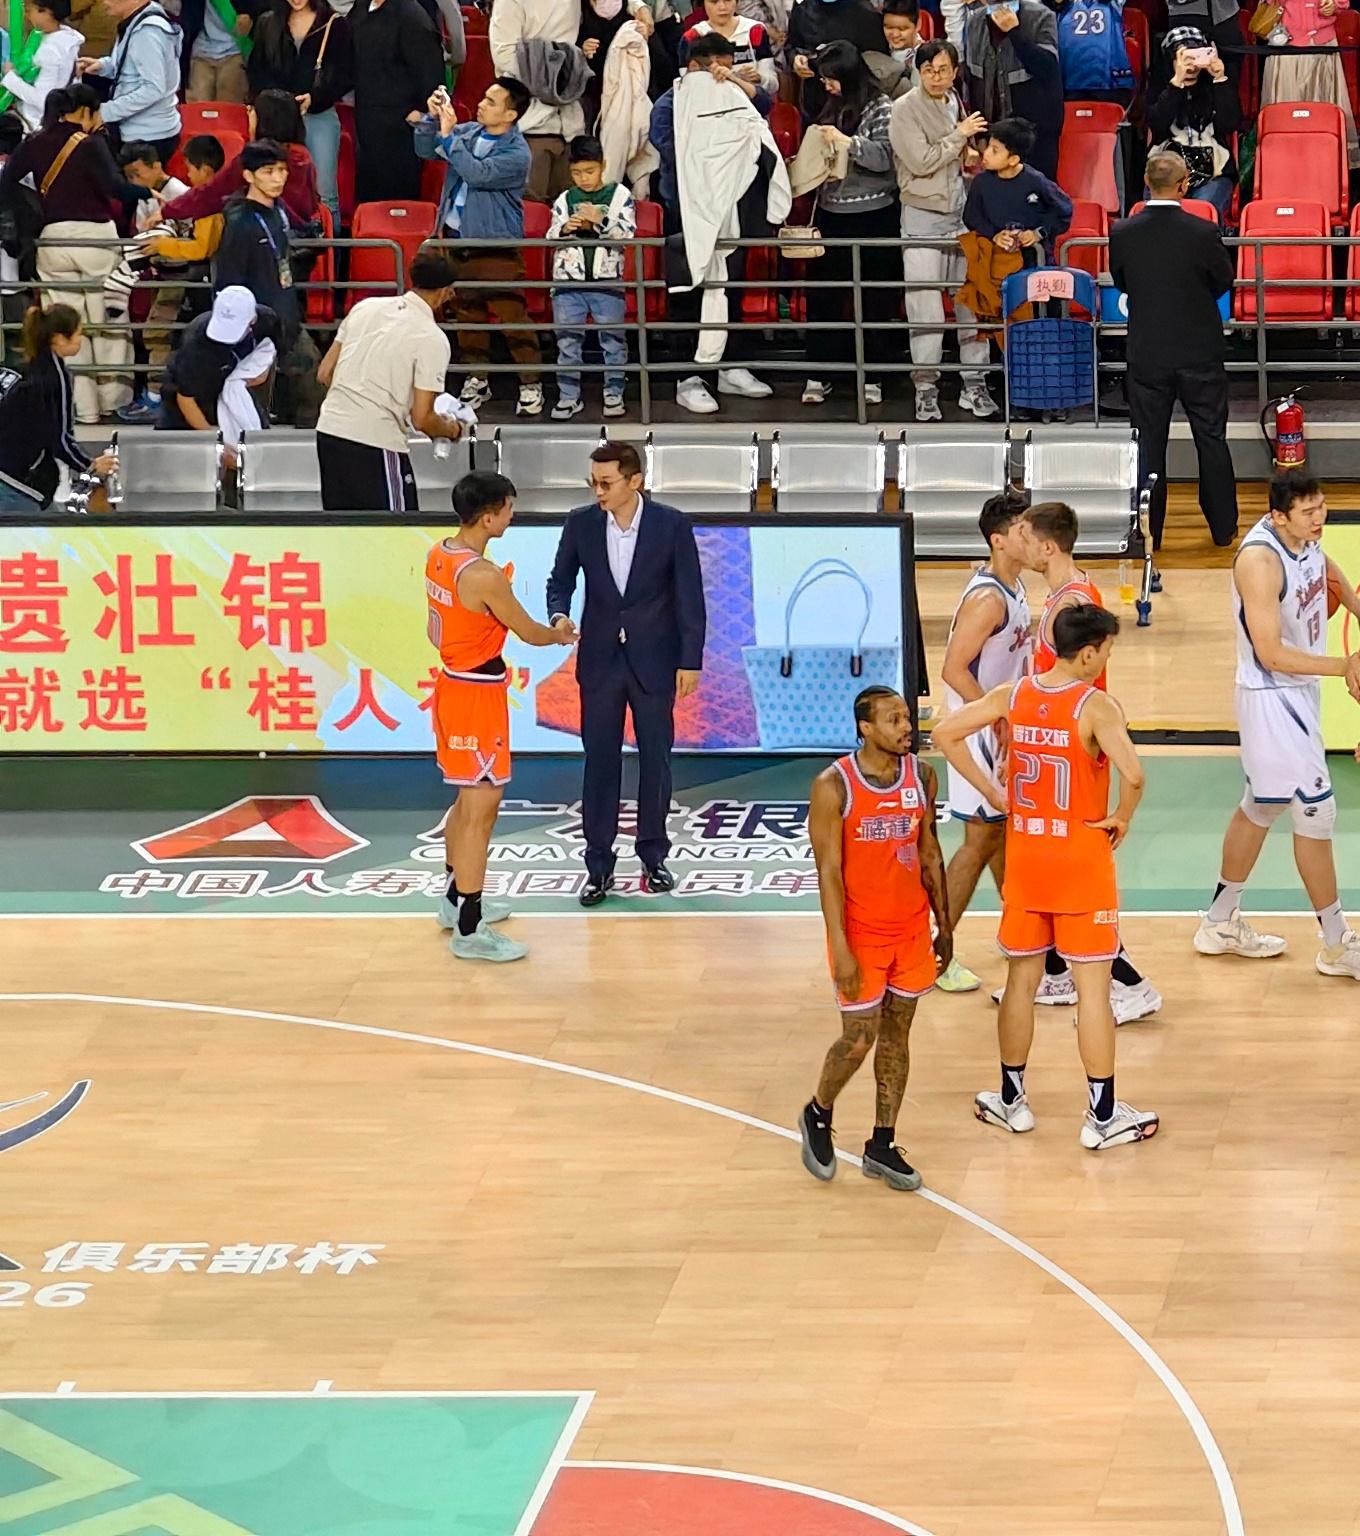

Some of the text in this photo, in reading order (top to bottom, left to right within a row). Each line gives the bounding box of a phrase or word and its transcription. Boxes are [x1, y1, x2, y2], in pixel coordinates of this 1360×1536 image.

[1073, 9, 1105, 35] 23
[1013, 750, 1071, 811] 27
[418, 845, 558, 860] CINA
[40, 1240, 386, 1275] 俱乐部杯
